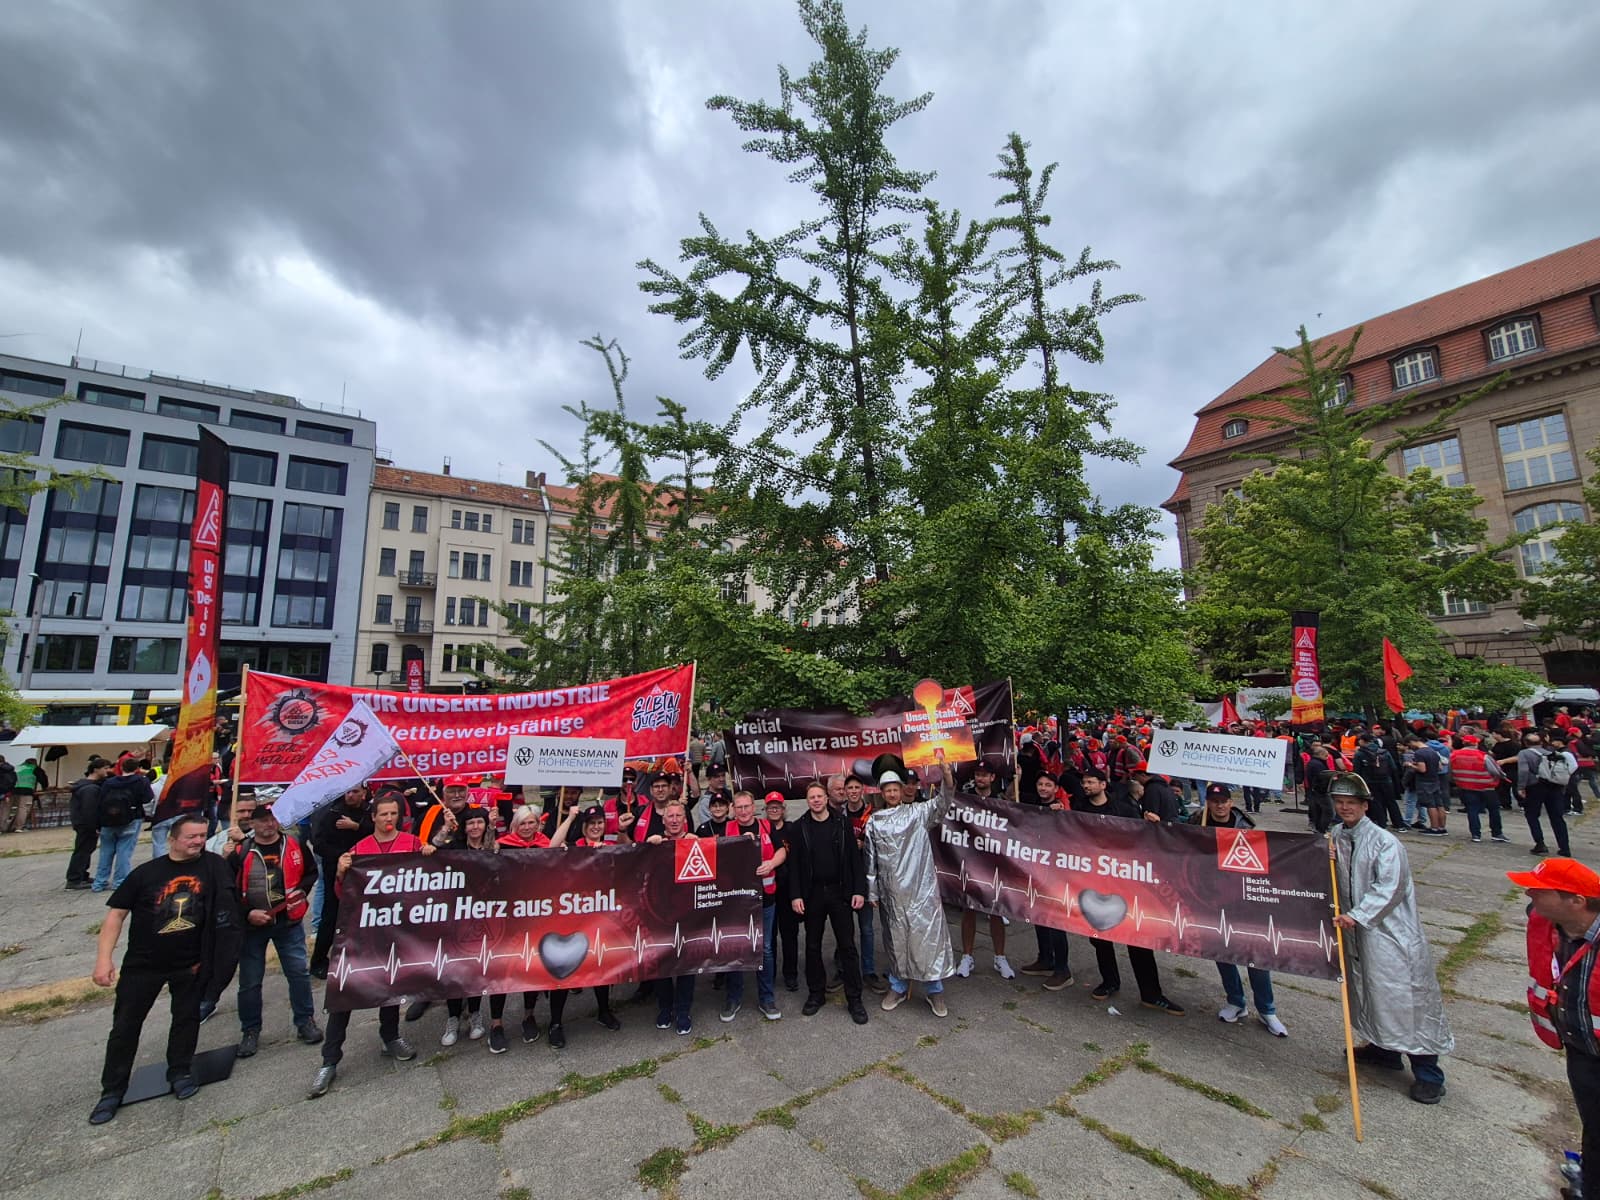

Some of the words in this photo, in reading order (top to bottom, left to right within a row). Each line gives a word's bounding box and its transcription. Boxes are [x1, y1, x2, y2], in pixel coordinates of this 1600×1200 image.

[498, 684, 611, 711] INDUSTRIE
[734, 718, 782, 735] Freital
[736, 739, 761, 755] hat
[764, 738, 788, 754] ein
[792, 736, 828, 752] Herz
[831, 734, 858, 749] aus
[1184, 742, 1277, 759] MANNESMANN
[382, 745, 507, 770] nergiepreis
[539, 748, 618, 759] MANNESMANN
[1182, 751, 1271, 768] RÖHRENWERK
[538, 757, 614, 768] RÖHRENWERK
[945, 803, 1009, 832] Gröditz
[940, 824, 970, 848] hat
[974, 833, 1002, 855] ein
[1005, 838, 1051, 866] Herz
[1055, 853, 1092, 873] aus
[1097, 855, 1160, 884] Stahl.
[363, 866, 466, 895] Zeithain
[697, 884, 717, 892] Bezirk
[1246, 877, 1271, 885] Bezirk
[697, 888, 758, 900] Berlin-Brandenburg-
[1246, 886, 1328, 900] Berlin-Brandenburg-
[1246, 894, 1280, 904] Sachsen
[360, 902, 403, 928] hat
[409, 898, 448, 924] ein
[455, 896, 507, 920] Herz
[513, 898, 553, 918] aus
[558, 888, 623, 915] Stahl.
[697, 900, 723, 909] Sachsen
